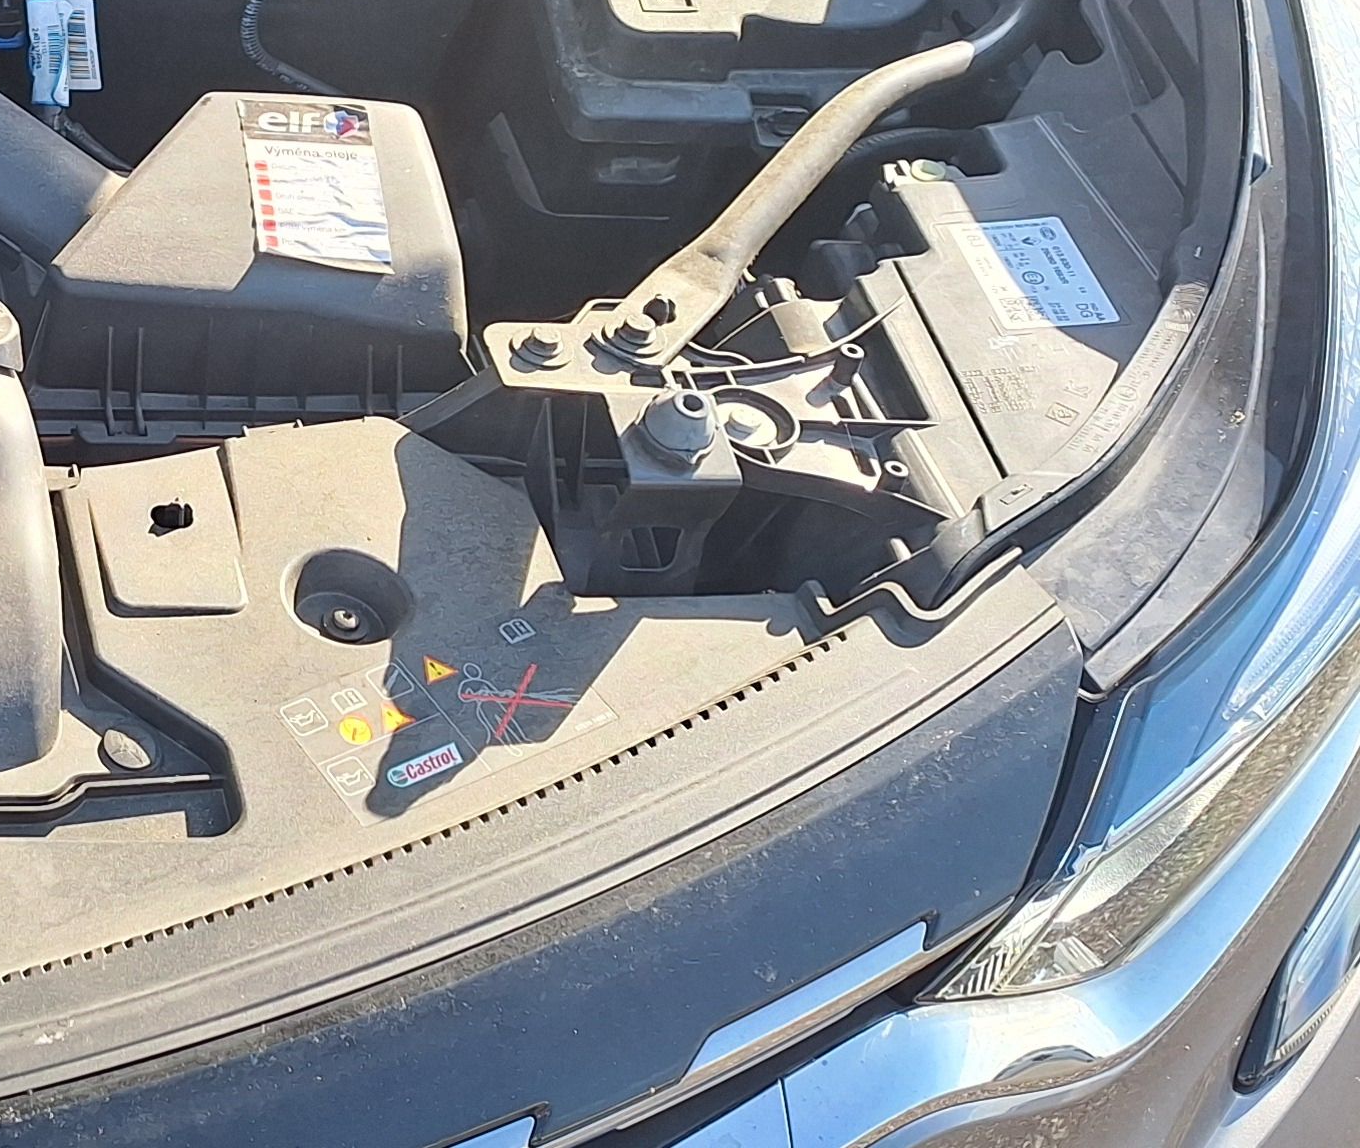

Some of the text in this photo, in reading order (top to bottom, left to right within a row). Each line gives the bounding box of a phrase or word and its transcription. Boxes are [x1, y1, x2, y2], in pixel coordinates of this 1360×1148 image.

[258, 110, 322, 134] elf
[1073, 302, 1095, 318] DG
[406, 748, 457, 779] Castrol
